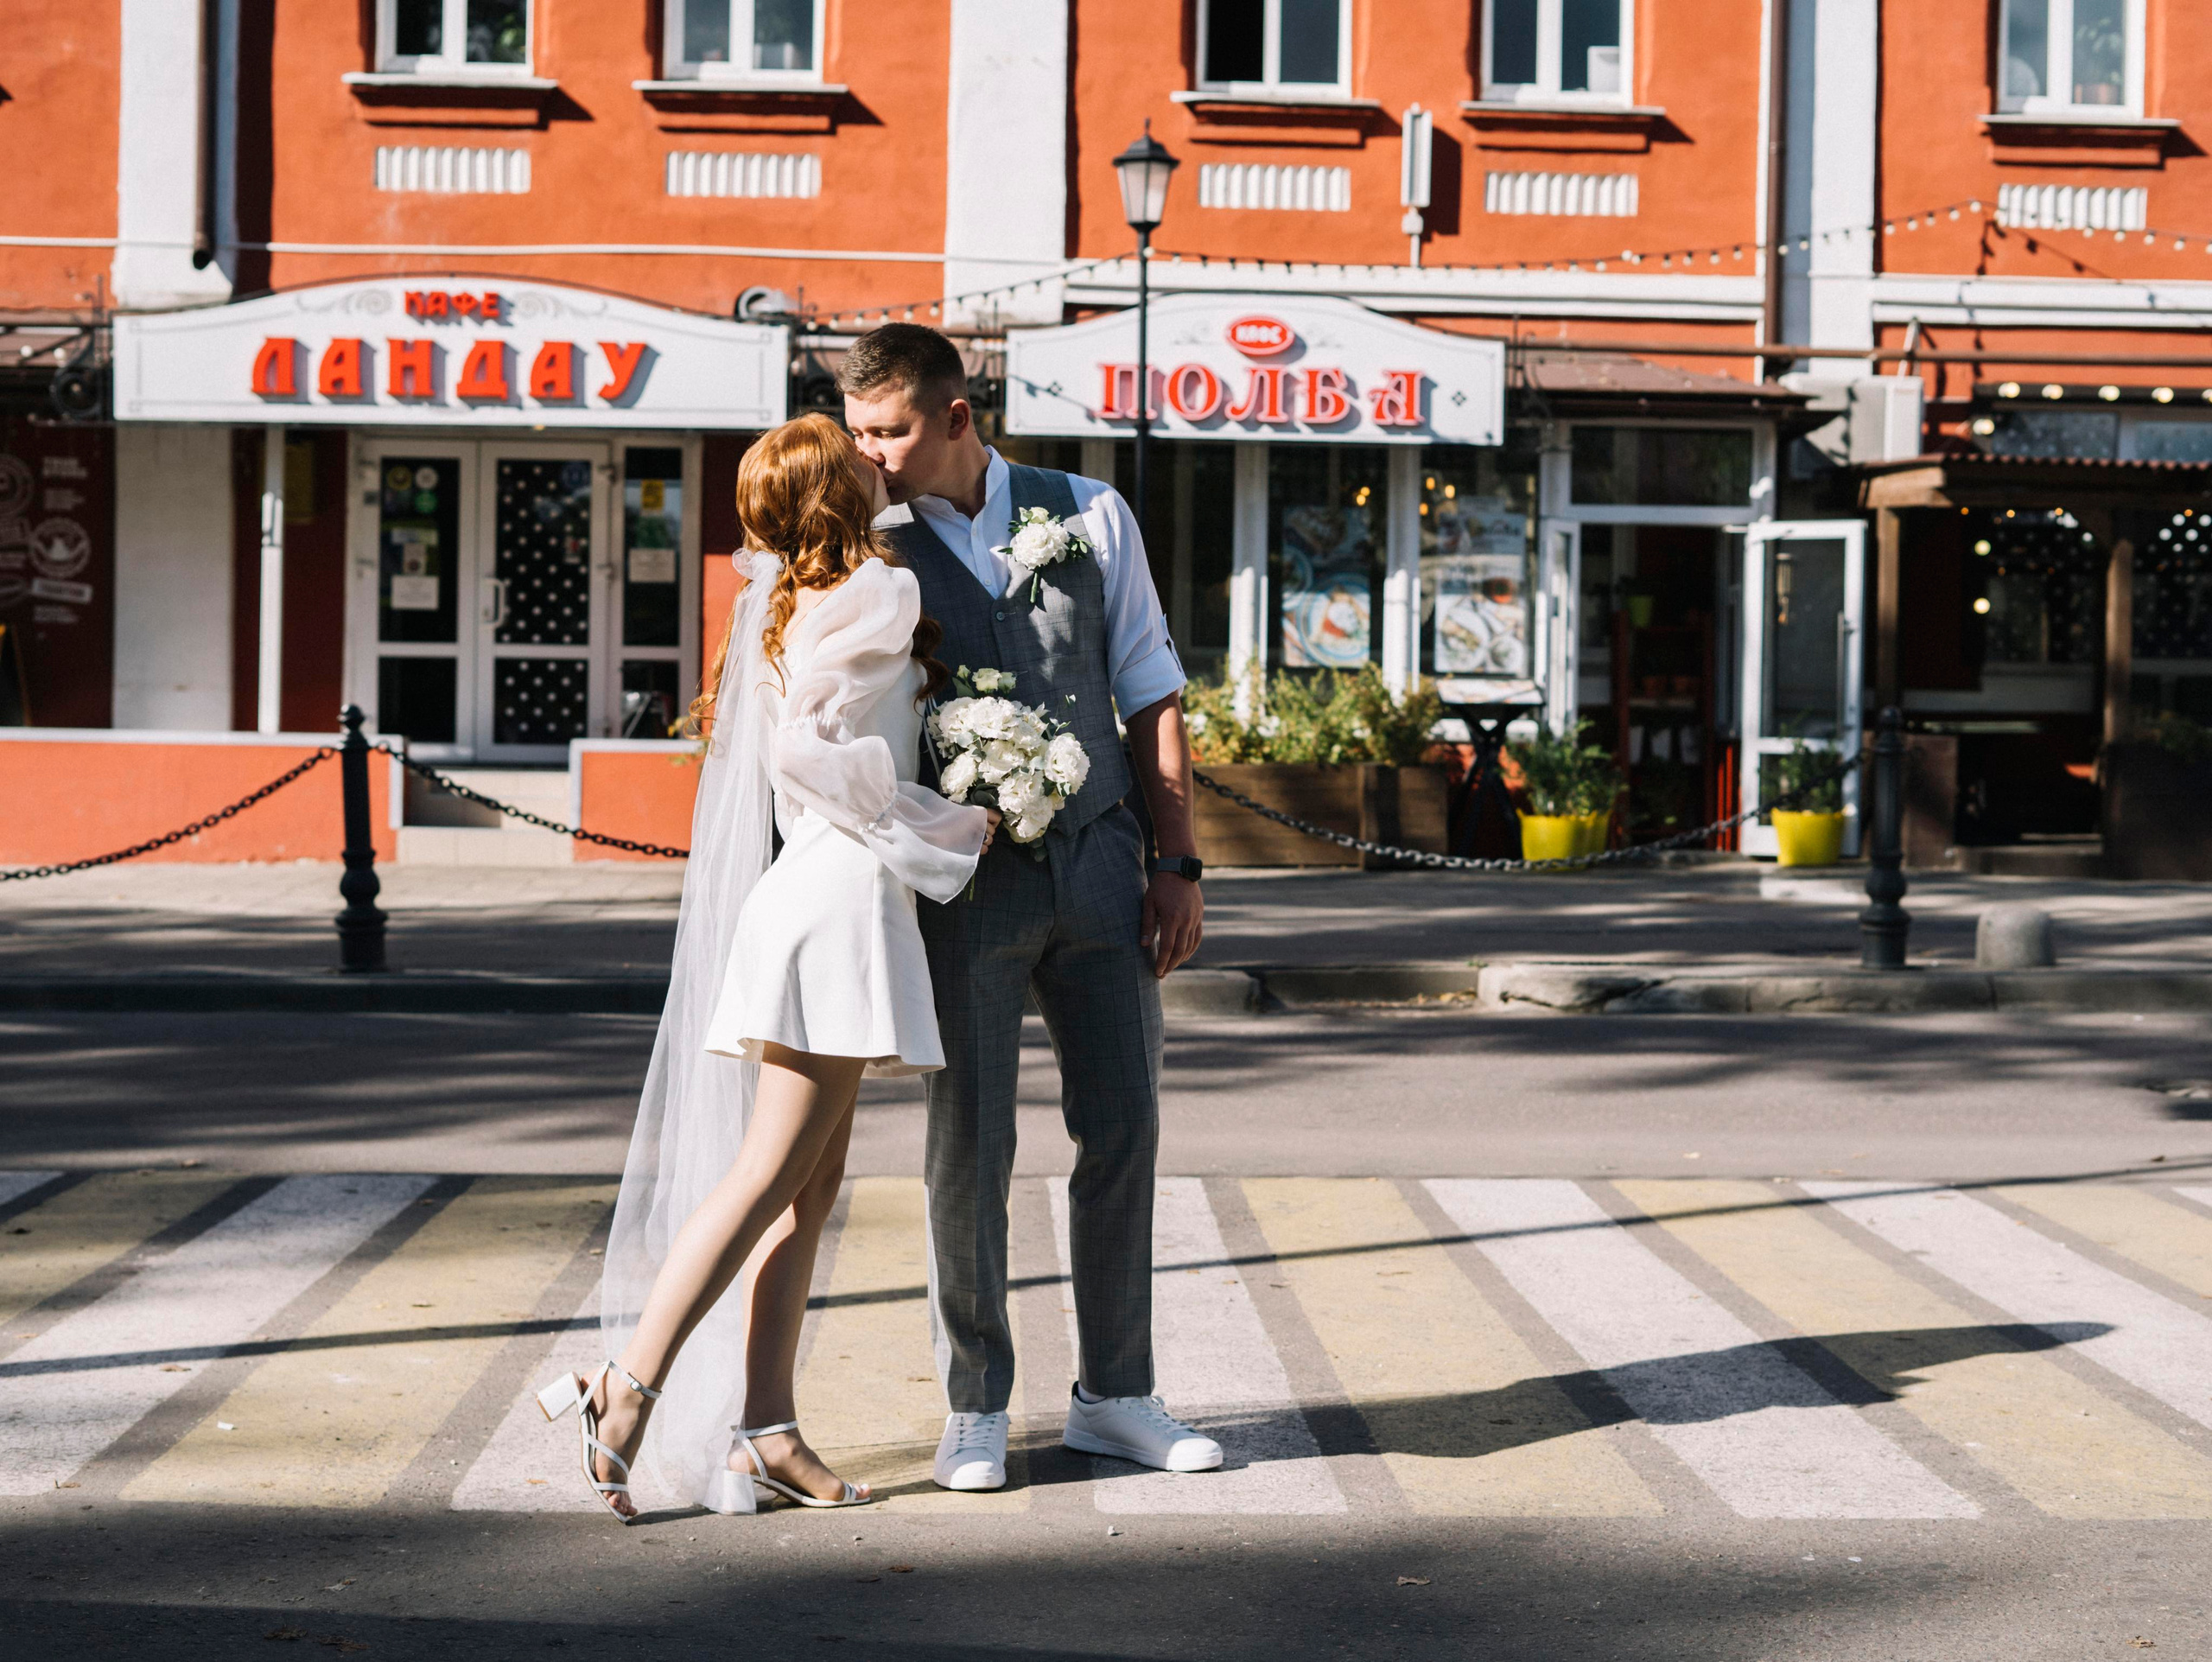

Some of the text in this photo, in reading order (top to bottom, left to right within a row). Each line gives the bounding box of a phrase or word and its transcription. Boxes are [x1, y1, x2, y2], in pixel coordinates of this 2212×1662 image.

[404, 291, 501, 317] КАФЕ
[251, 337, 647, 399] ЛАНДАУ
[1094, 363, 1425, 424] ПОЛБА
